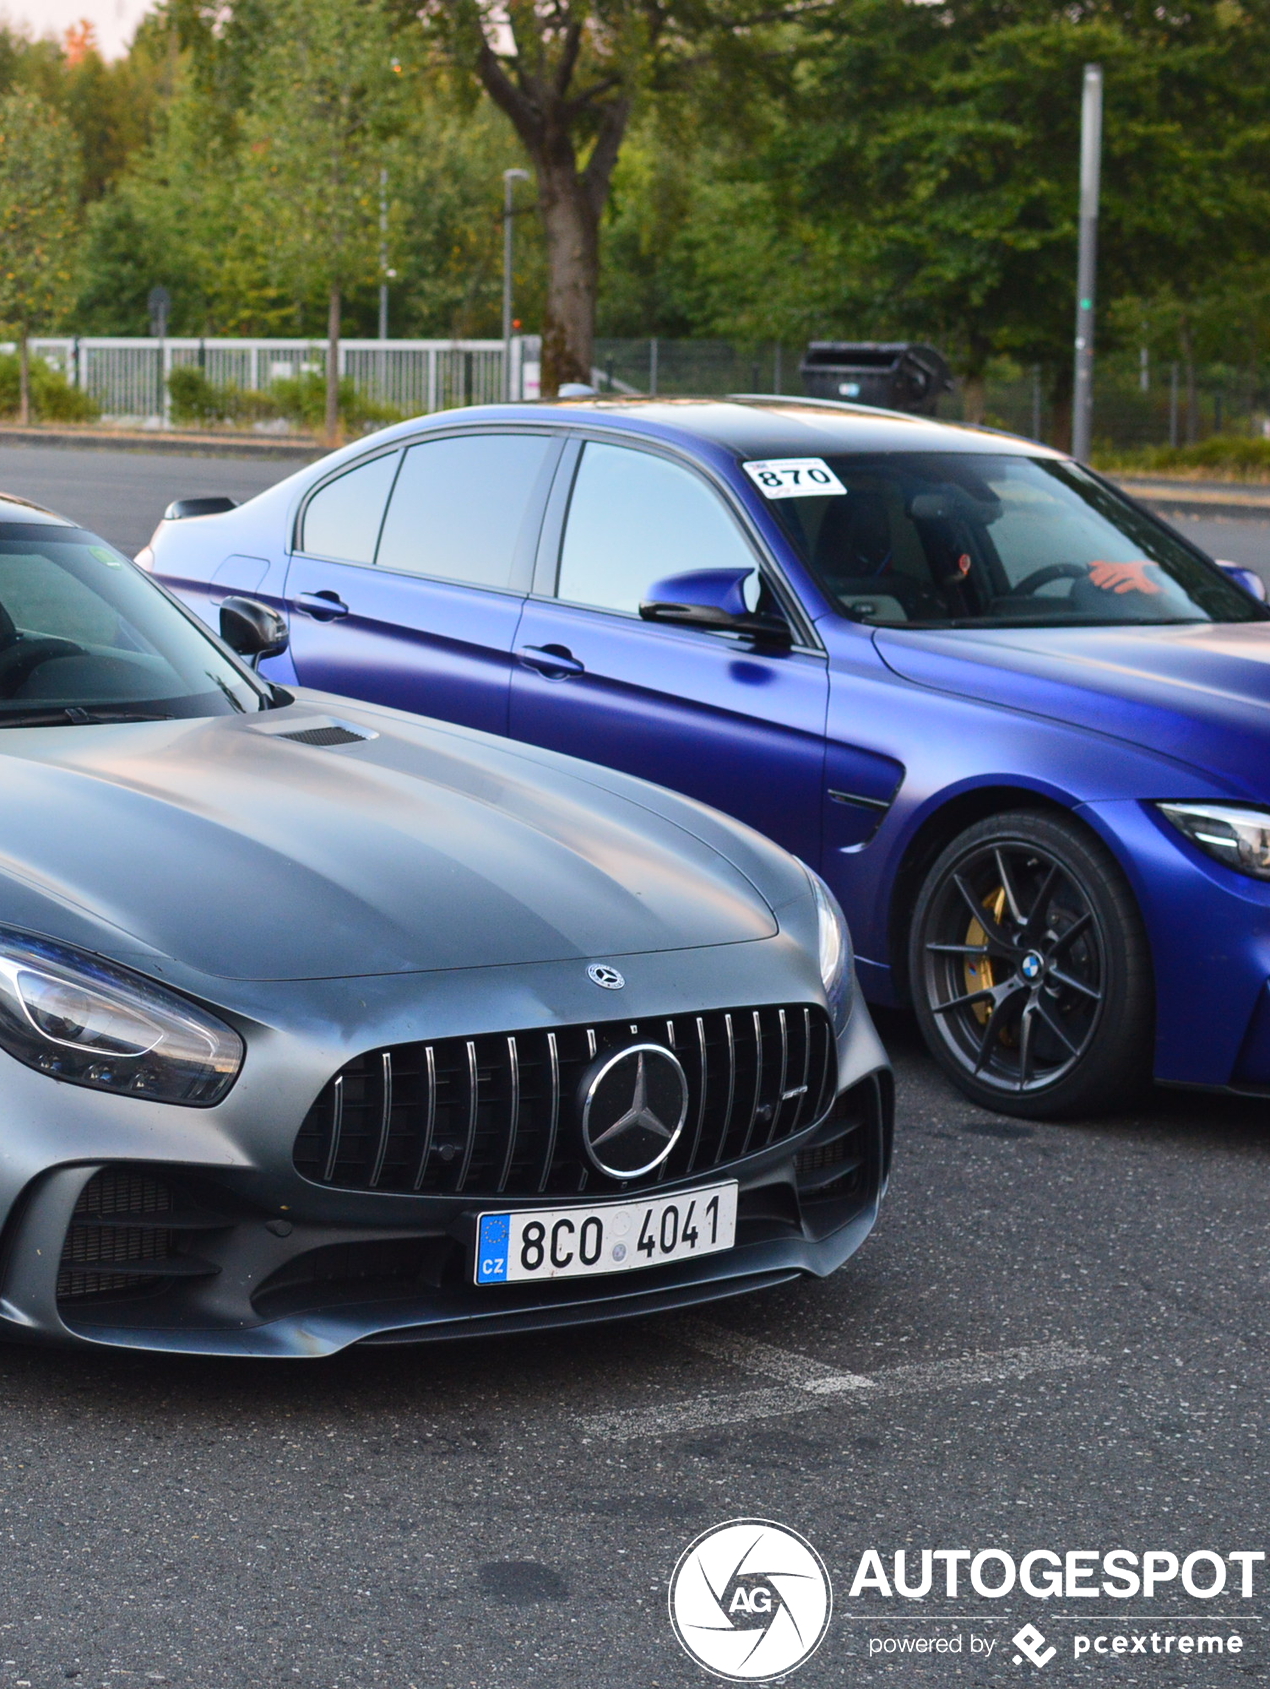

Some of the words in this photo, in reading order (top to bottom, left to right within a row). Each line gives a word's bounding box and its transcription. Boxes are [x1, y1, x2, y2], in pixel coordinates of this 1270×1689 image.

[758, 469, 831, 487] 870
[637, 1195, 720, 1258] 4041
[482, 1258, 504, 1274] CZ
